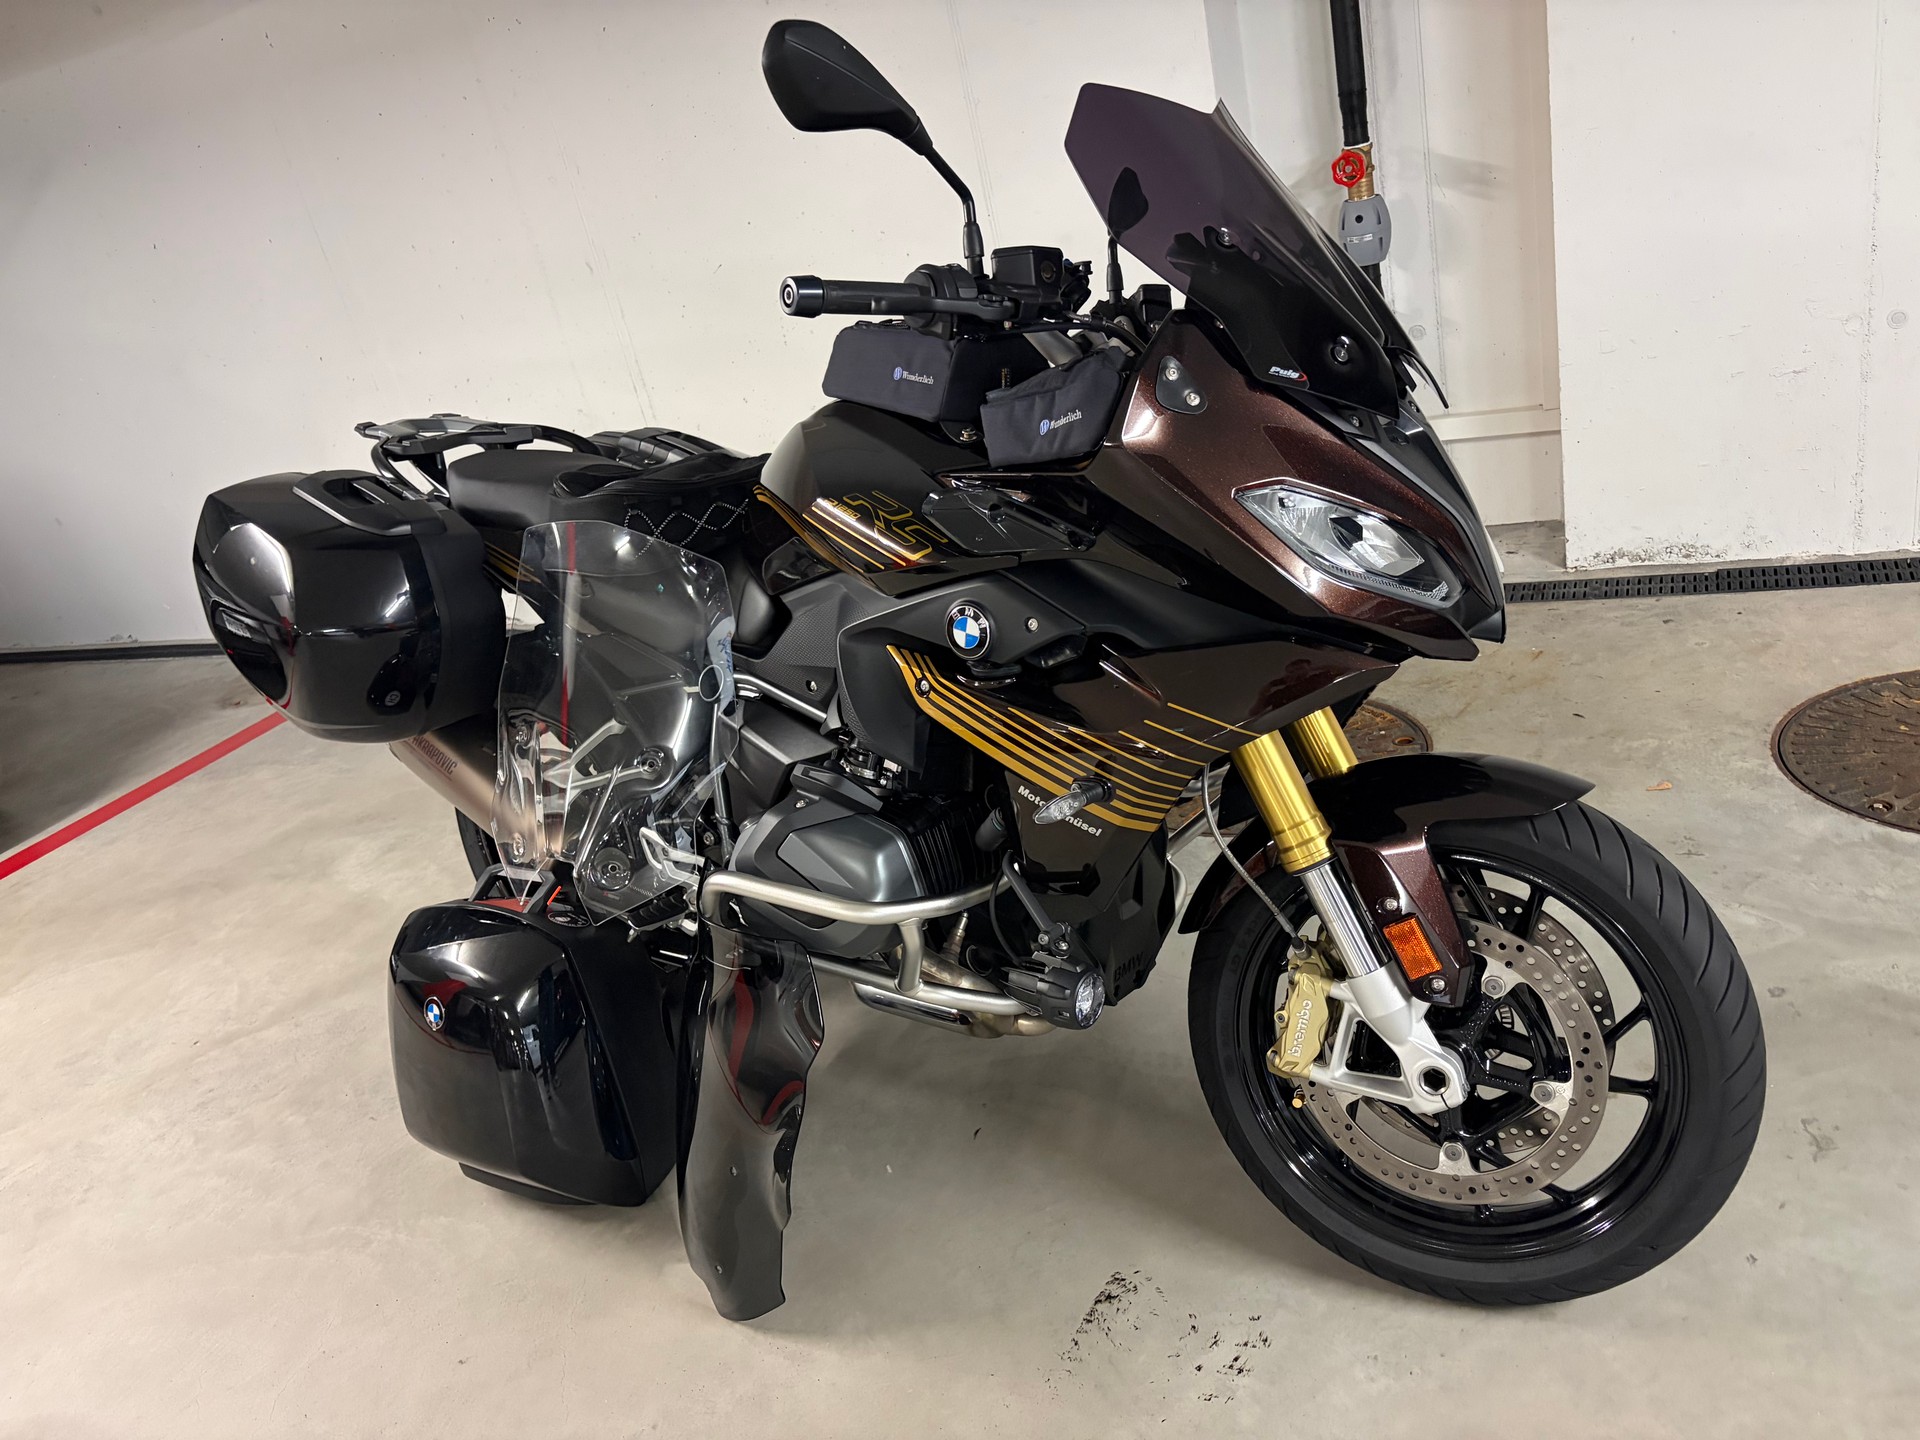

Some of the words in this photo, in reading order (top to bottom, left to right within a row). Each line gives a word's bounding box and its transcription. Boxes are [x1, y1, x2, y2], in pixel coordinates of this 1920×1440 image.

[1269, 366, 1300, 379] Puig
[951, 606, 988, 628] BMW
[1288, 1000, 1313, 1057] brembo
